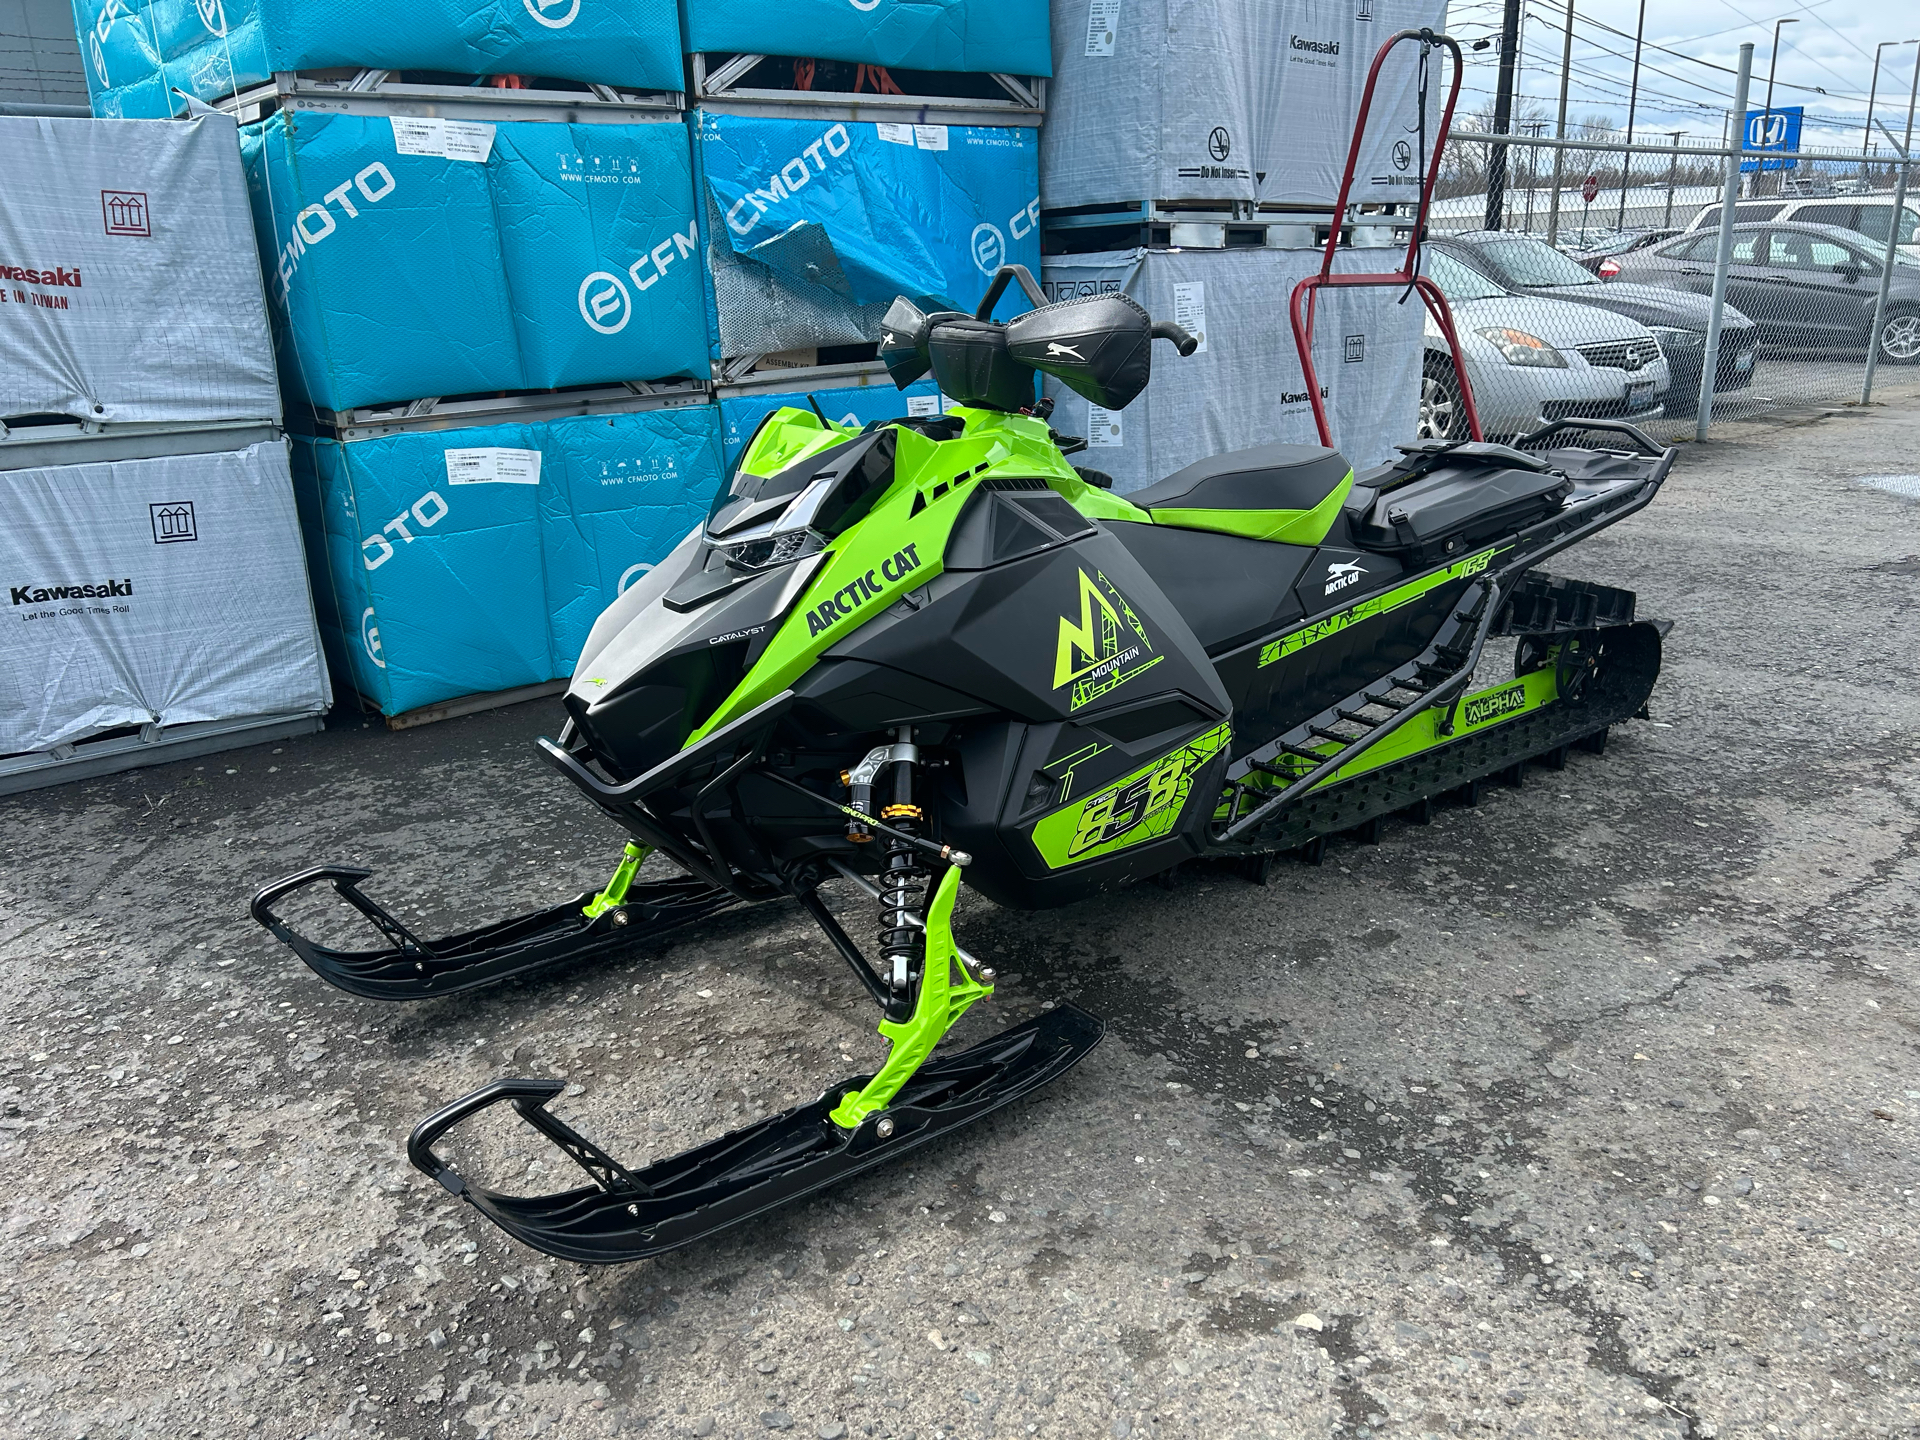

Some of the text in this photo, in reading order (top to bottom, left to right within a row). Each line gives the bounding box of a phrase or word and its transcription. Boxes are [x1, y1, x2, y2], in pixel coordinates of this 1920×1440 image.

[1290, 34, 1340, 55] Kawasaki
[1201, 166, 1210, 179] Do
[1210, 166, 1221, 179] Not
[271, 161, 396, 309] CFMOTO
[13, 290, 26, 304] IN
[765, 358, 798, 369] ASSEMBLY
[1280, 386, 1329, 404] Kawaki
[1460, 553, 1491, 580] 165
[10, 579, 133, 606] Kawasaki
[805, 542, 923, 638] ARCTIC CAT
[1325, 571, 1360, 596] ARCTIC CAT
[22, 612, 38, 622] Let
[40, 611, 56, 619] the
[59, 607, 84, 616] Good
[112, 605, 130, 613] Roll
[709, 625, 767, 645] CATALYST
[1091, 646, 1140, 681] MOUNTAIN
[1469, 691, 1521, 722] ALPHA
[1067, 758, 1185, 857] 858
